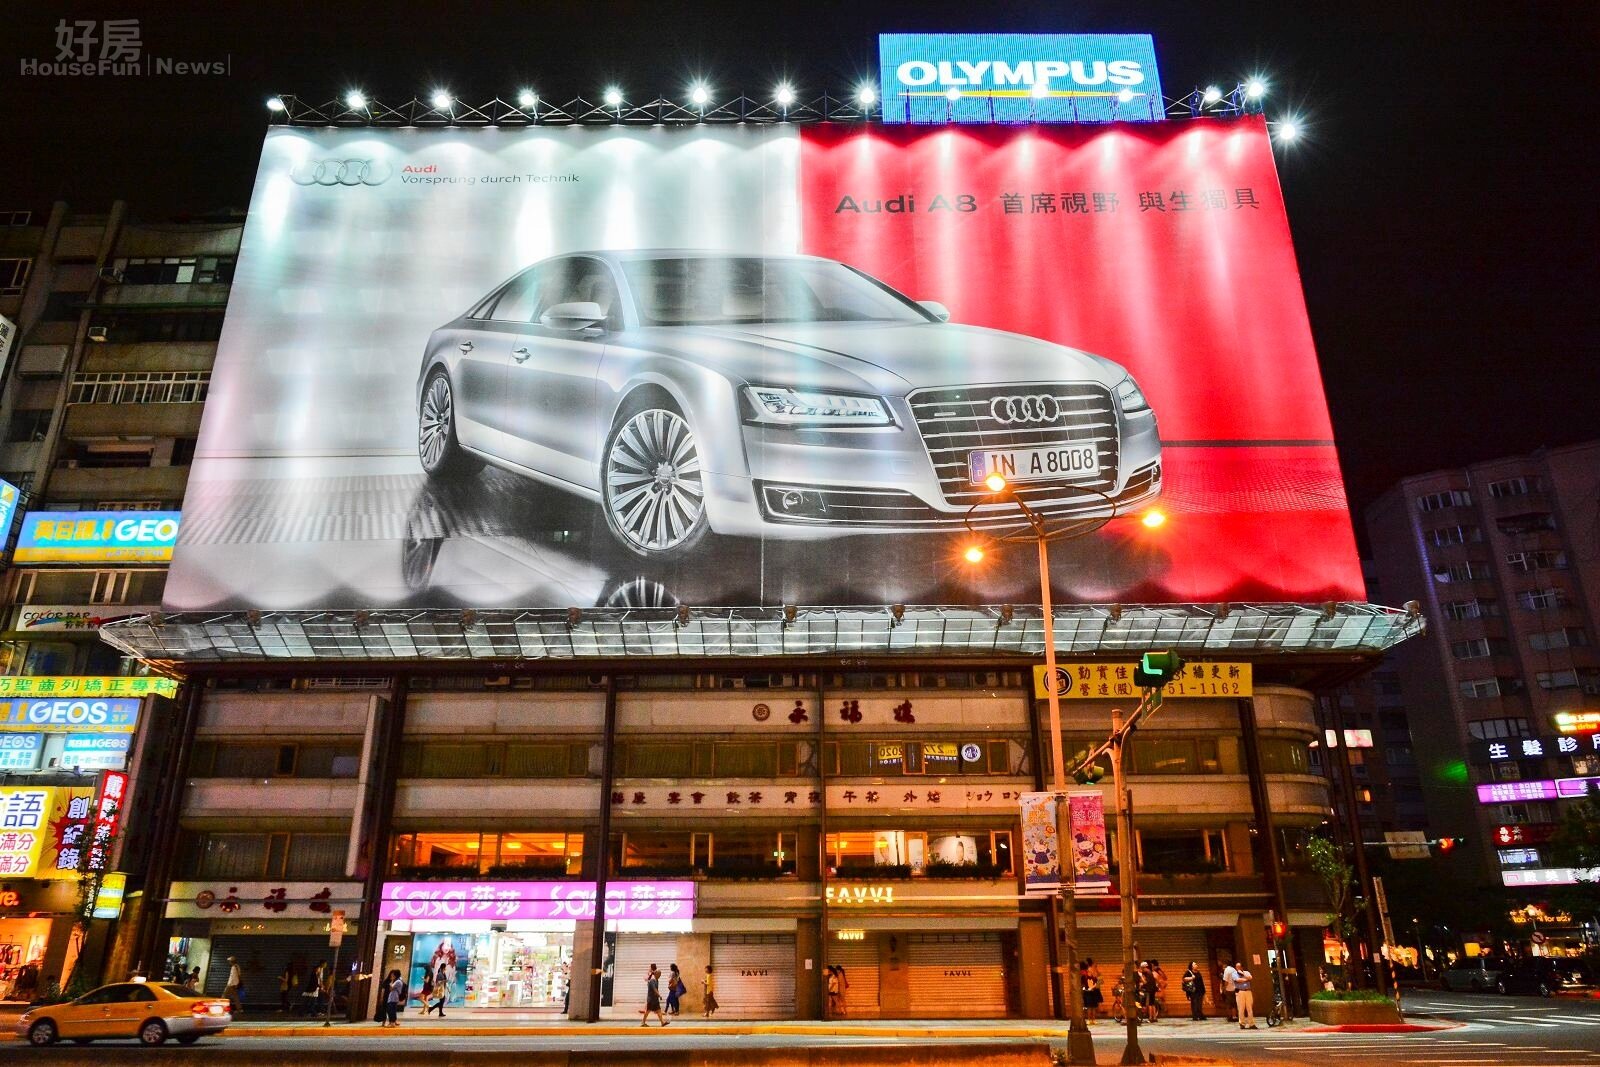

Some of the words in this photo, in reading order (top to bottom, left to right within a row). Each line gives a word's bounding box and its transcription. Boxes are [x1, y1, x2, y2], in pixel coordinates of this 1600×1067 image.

[896, 60, 1145, 87] OLYMPUS
[402, 164, 437, 174] Audi
[401, 175, 476, 185] Vorsprung
[480, 174, 521, 184] durch
[525, 173, 580, 183] Technik
[834, 194, 915, 214] Audi
[927, 194, 978, 213] A8
[1001, 192, 1121, 215] 首席視野
[1139, 188, 1260, 213] 與生獨具
[991, 453, 1016, 476] IN
[114, 519, 178, 542] GEO
[24, 612, 62, 620] COLOR
[1162, 682, 1240, 695] 51-1162
[29, 701, 108, 724] GEOS
[96, 738, 127, 749] GEOS
[469, 885, 522, 917] 莎莎
[629, 885, 682, 917] 莎莎
[825, 887, 893, 903] FAVVI
[838, 930, 865, 940] FAVVI
[393, 944, 406, 954] 59
[741, 969, 768, 977] FAVVI
[944, 969, 971, 977] FAVVI
